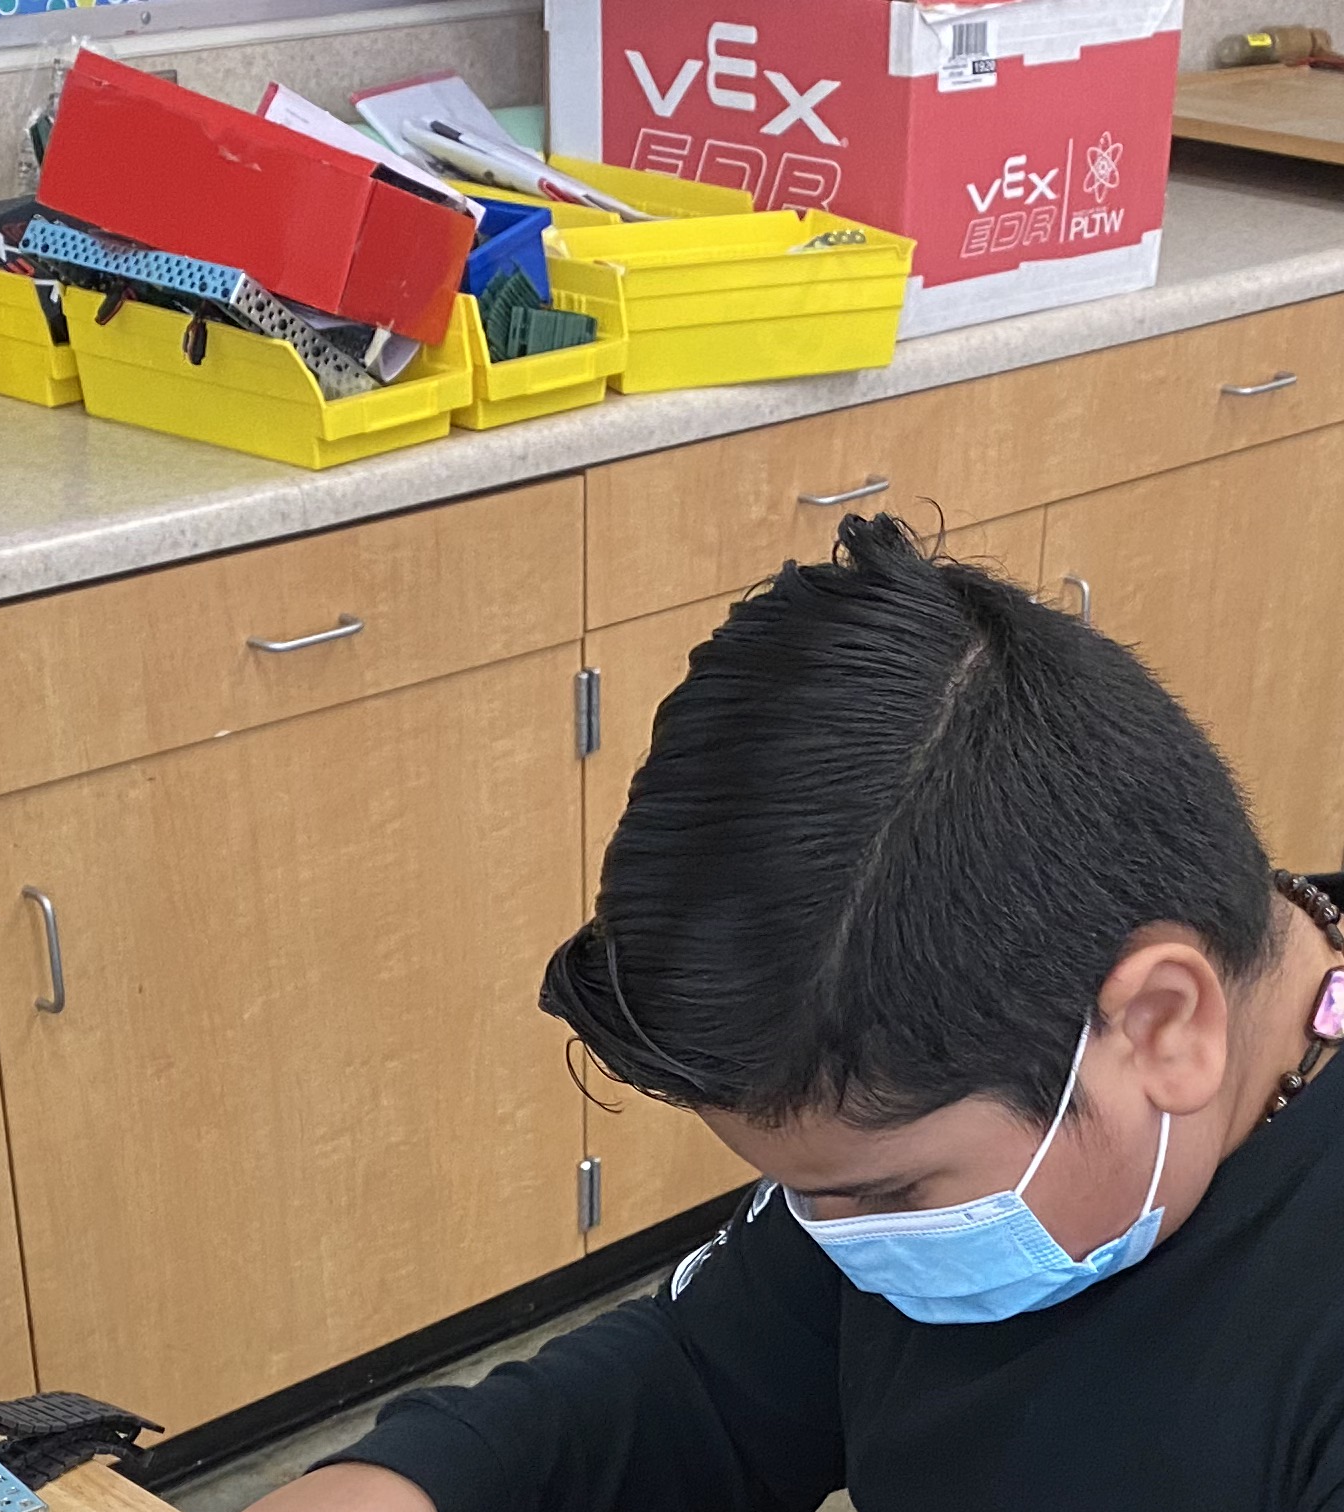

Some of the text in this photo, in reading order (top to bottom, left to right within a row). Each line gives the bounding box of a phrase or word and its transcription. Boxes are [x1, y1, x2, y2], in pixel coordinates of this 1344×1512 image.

[623, 21, 842, 147] VEX
[966, 154, 1059, 213] VEX
[960, 205, 1057, 258] EDR
[1069, 208, 1125, 242] PLTW
